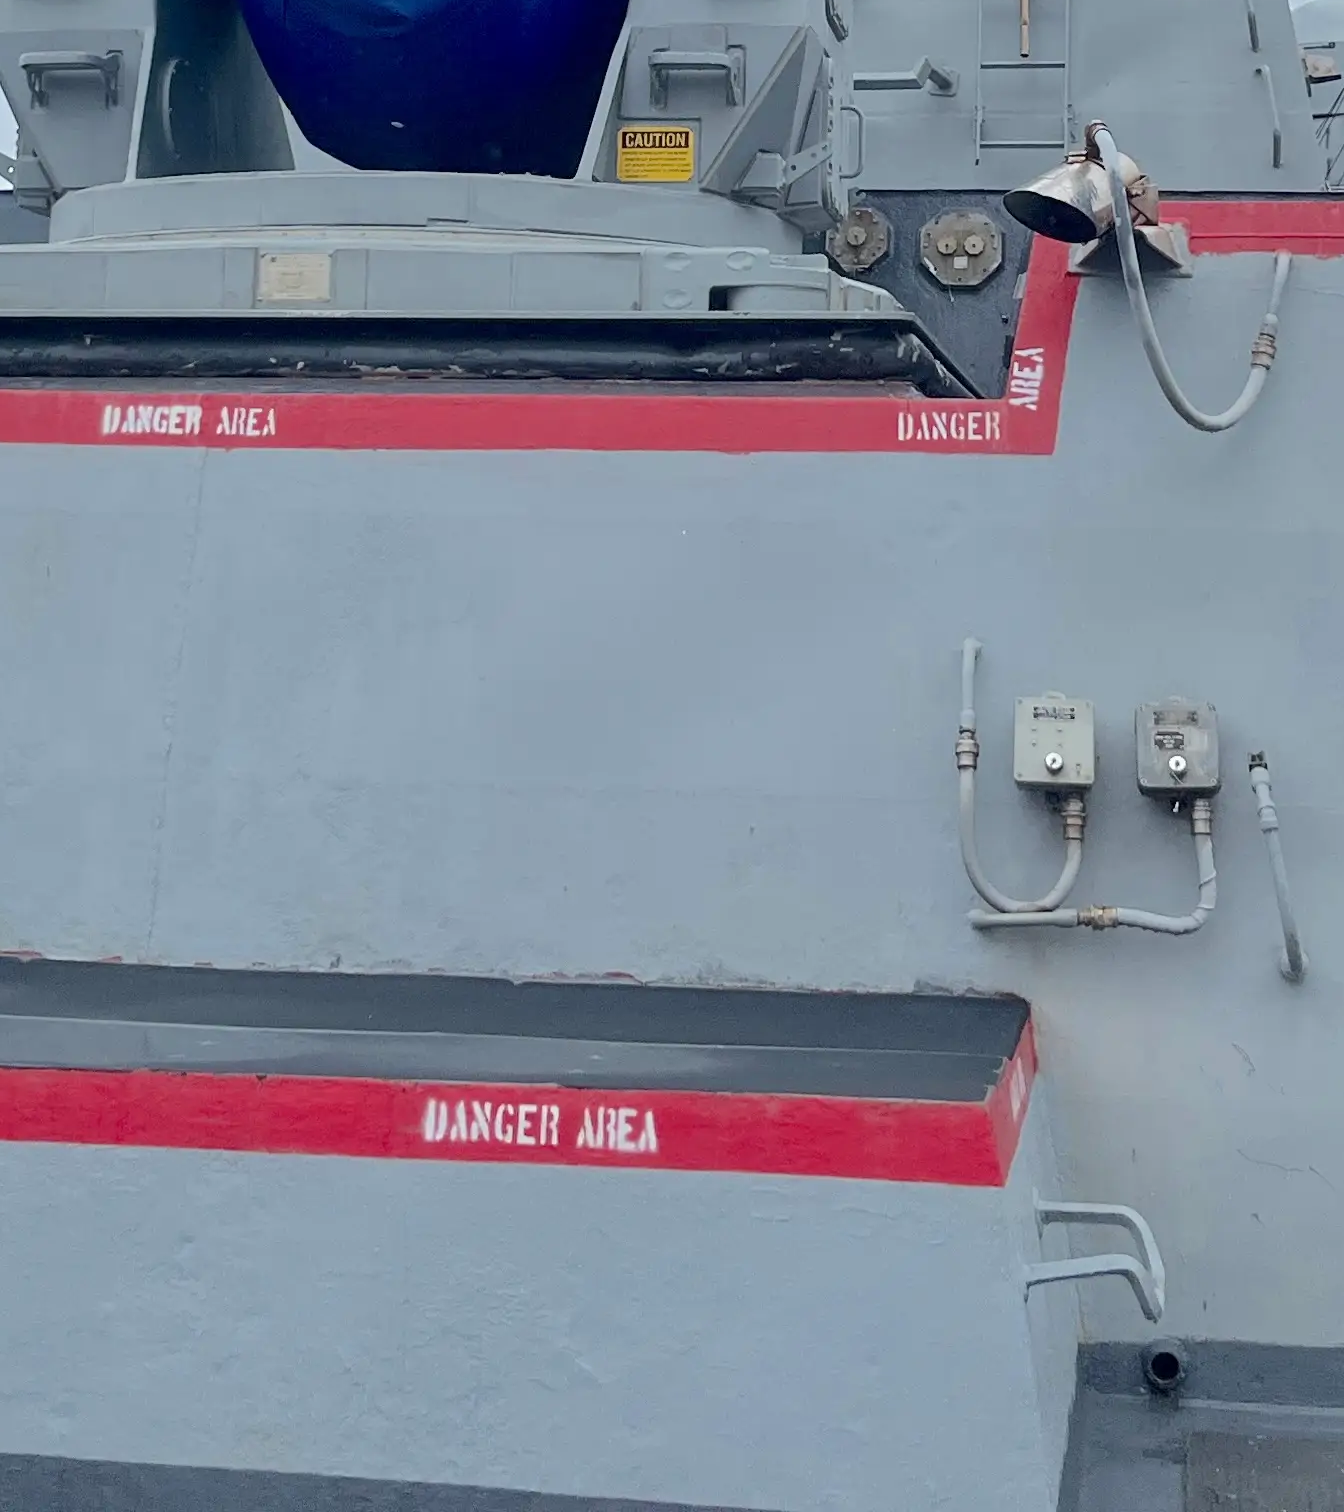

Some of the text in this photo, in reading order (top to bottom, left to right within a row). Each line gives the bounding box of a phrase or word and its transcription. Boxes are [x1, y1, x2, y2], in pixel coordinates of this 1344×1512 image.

[625, 132, 686, 148] CAUTION
[897, 346, 1045, 441] DANGER AREA
[101, 404, 276, 436] DANGER AREA
[422, 1098, 659, 1153] DANGER AREA
